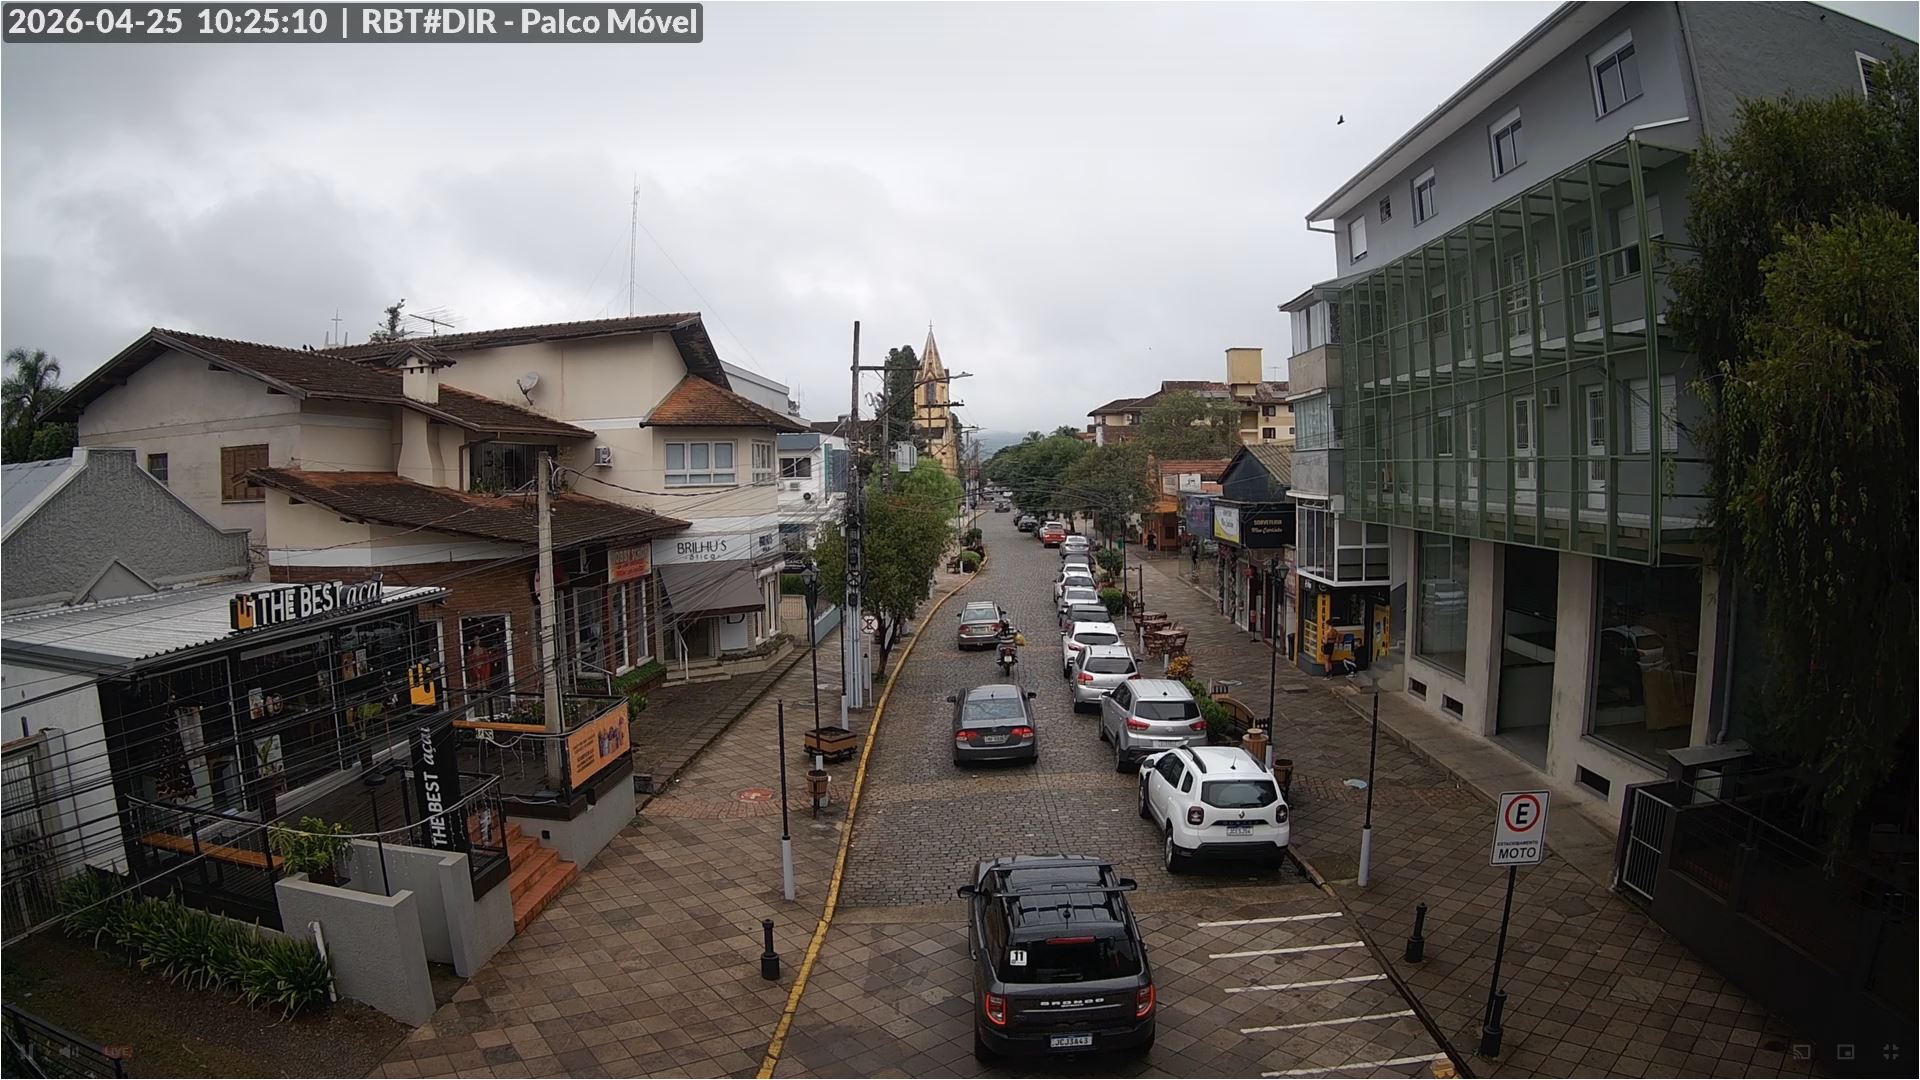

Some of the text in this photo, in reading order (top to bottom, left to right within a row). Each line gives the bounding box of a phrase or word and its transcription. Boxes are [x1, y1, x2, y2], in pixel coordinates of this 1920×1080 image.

[258, 588, 296, 626] THE
[300, 580, 343, 619] BEST
[423, 771, 443, 814] BEST
[1515, 803, 1530, 825] E
[431, 816, 448, 847] THE
[1498, 847, 1537, 860] MOTO
[1013, 951, 1024, 962] 11
